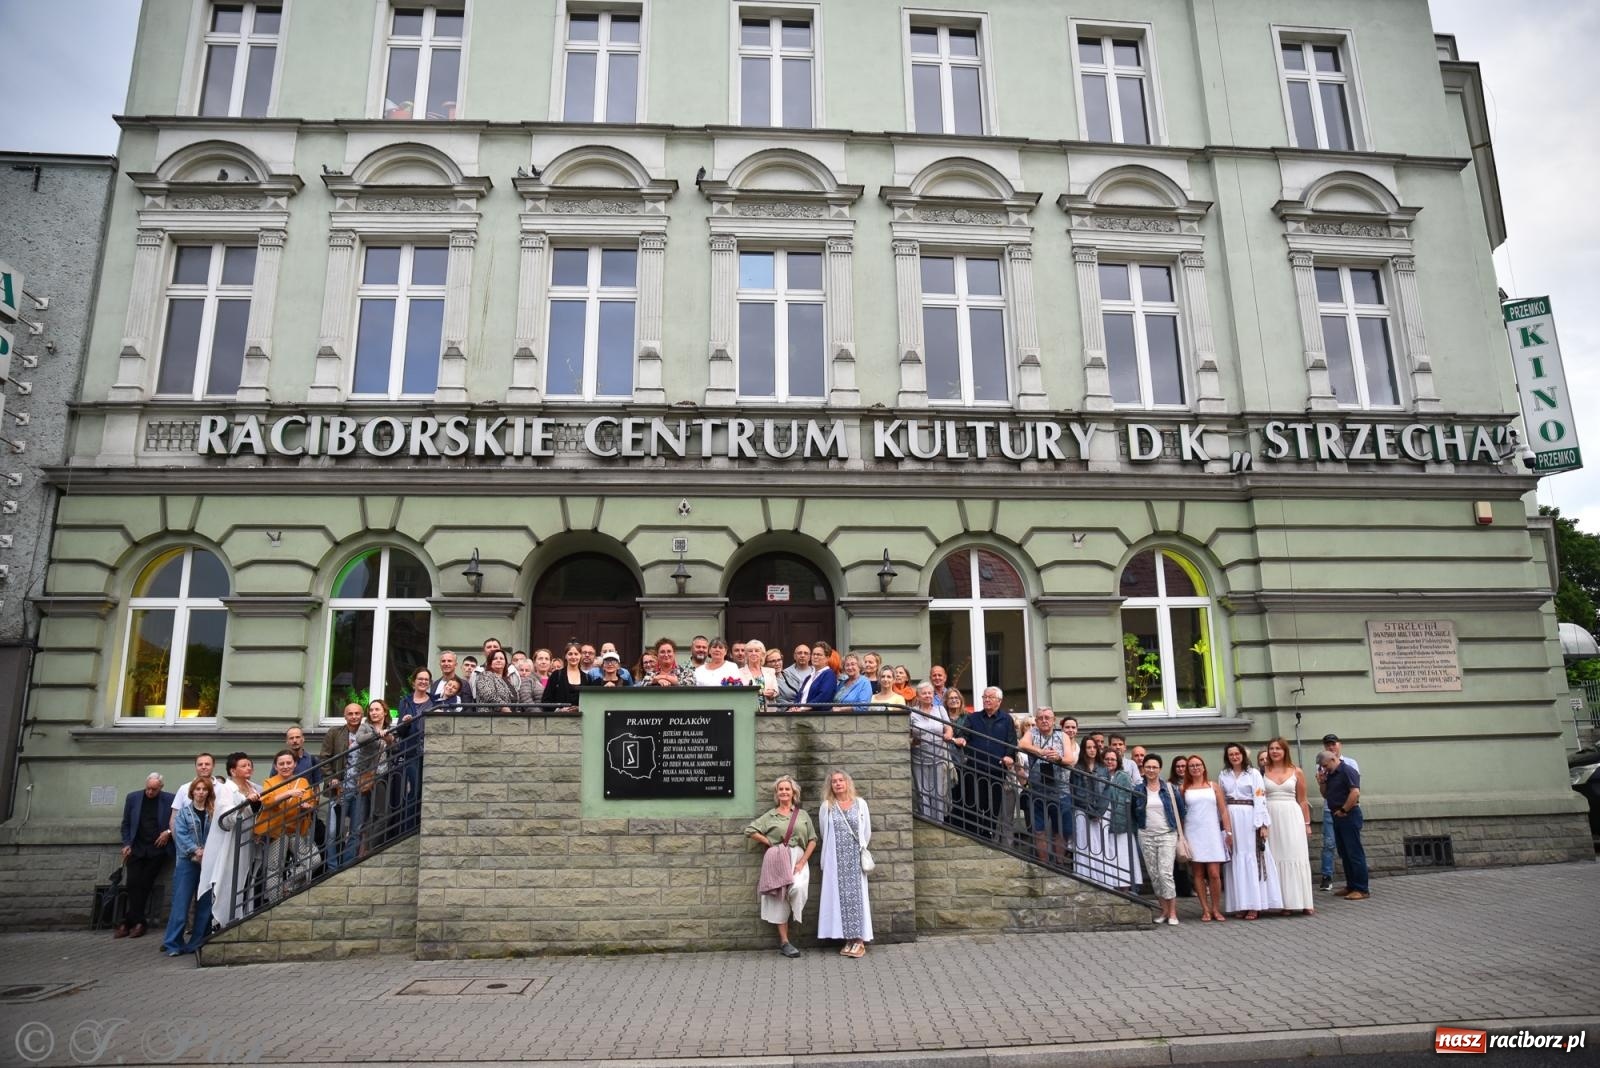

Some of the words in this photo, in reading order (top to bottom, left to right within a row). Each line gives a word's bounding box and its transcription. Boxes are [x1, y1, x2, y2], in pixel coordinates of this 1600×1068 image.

[1509, 301, 1546, 320] PRZEMKO
[1516, 322, 1566, 443] KINO
[197, 415, 556, 457] RACIBORSKIE
[583, 416, 849, 459] CENTRUM
[873, 418, 1098, 461] KULTURY
[1538, 453, 1577, 472] PRZEMKO
[1384, 622, 1437, 631] STRZECHA
[626, 717, 663, 726] PRAWDY
[669, 716, 712, 726] POLAKÓW
